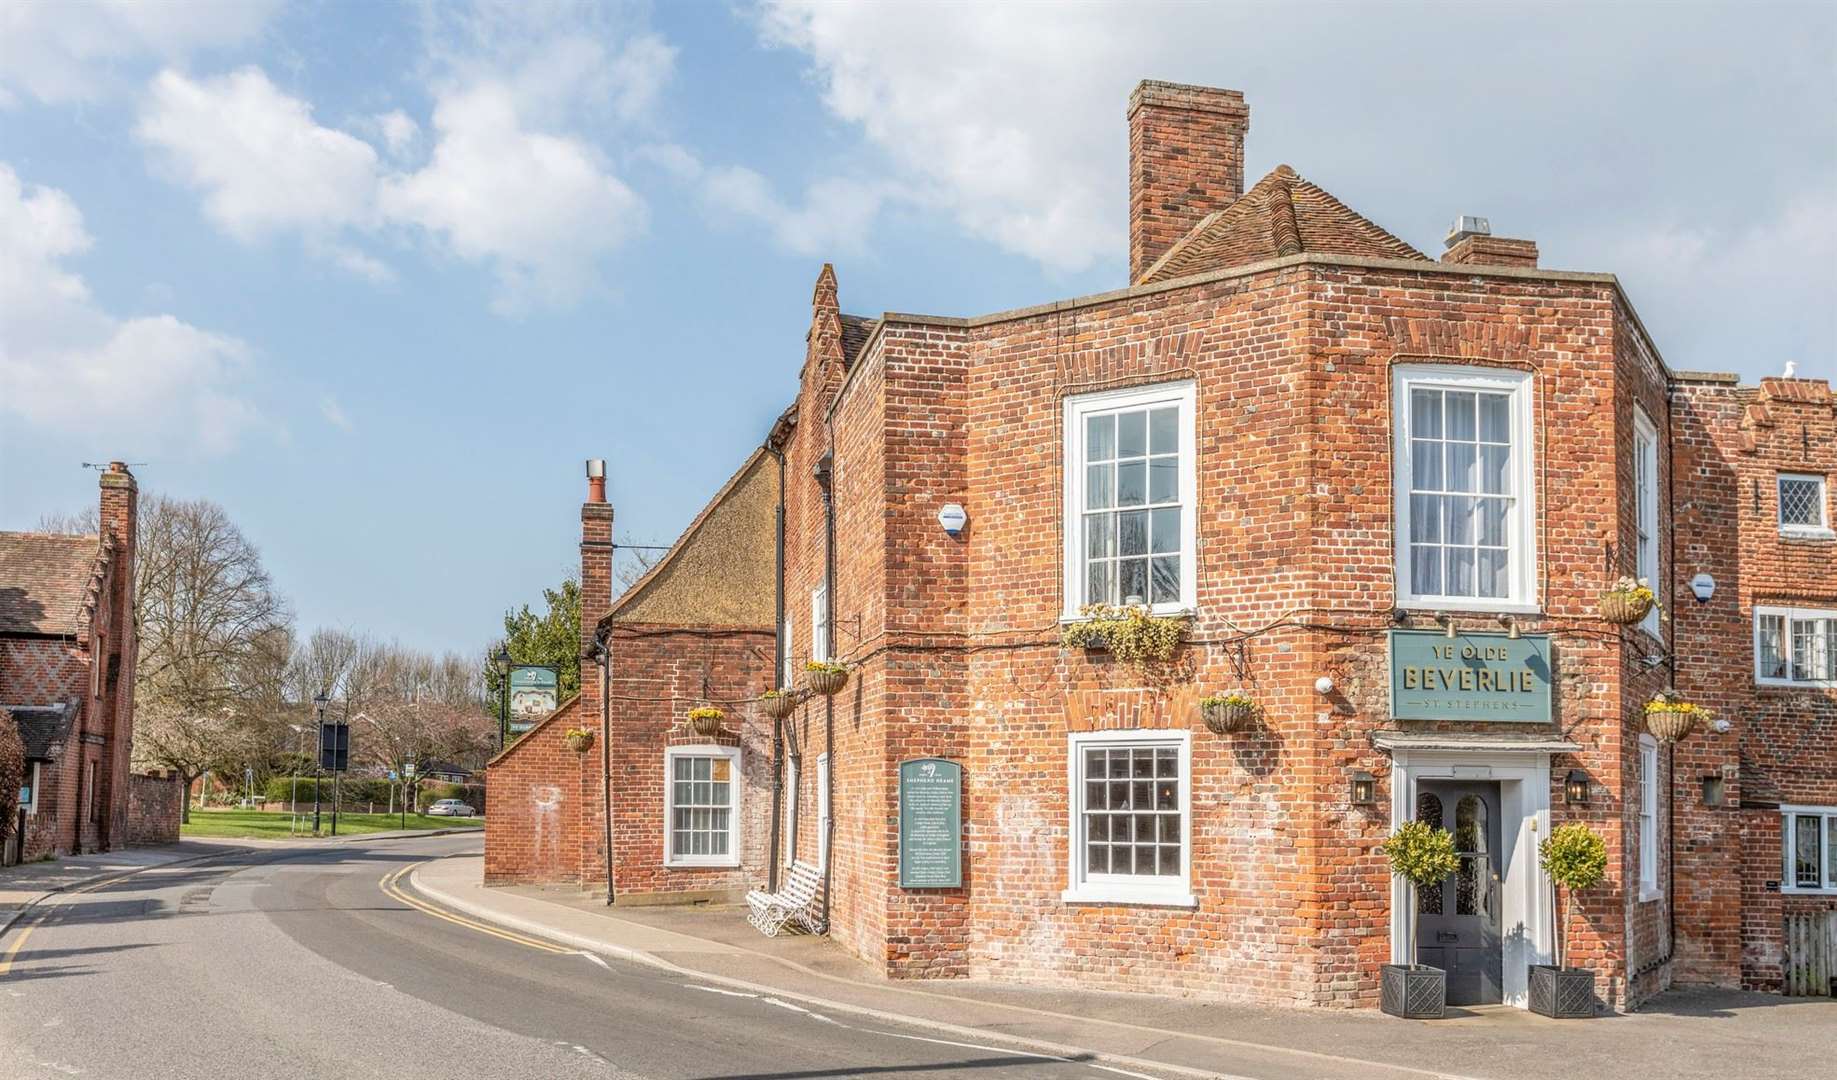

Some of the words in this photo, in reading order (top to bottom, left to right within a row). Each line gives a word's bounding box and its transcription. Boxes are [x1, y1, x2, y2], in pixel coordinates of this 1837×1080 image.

[1432, 645, 1453, 660] YE
[1461, 645, 1509, 662] OLDE
[1403, 665, 1534, 693] BEVERLIE
[1447, 698, 1518, 710] STEPHENS
